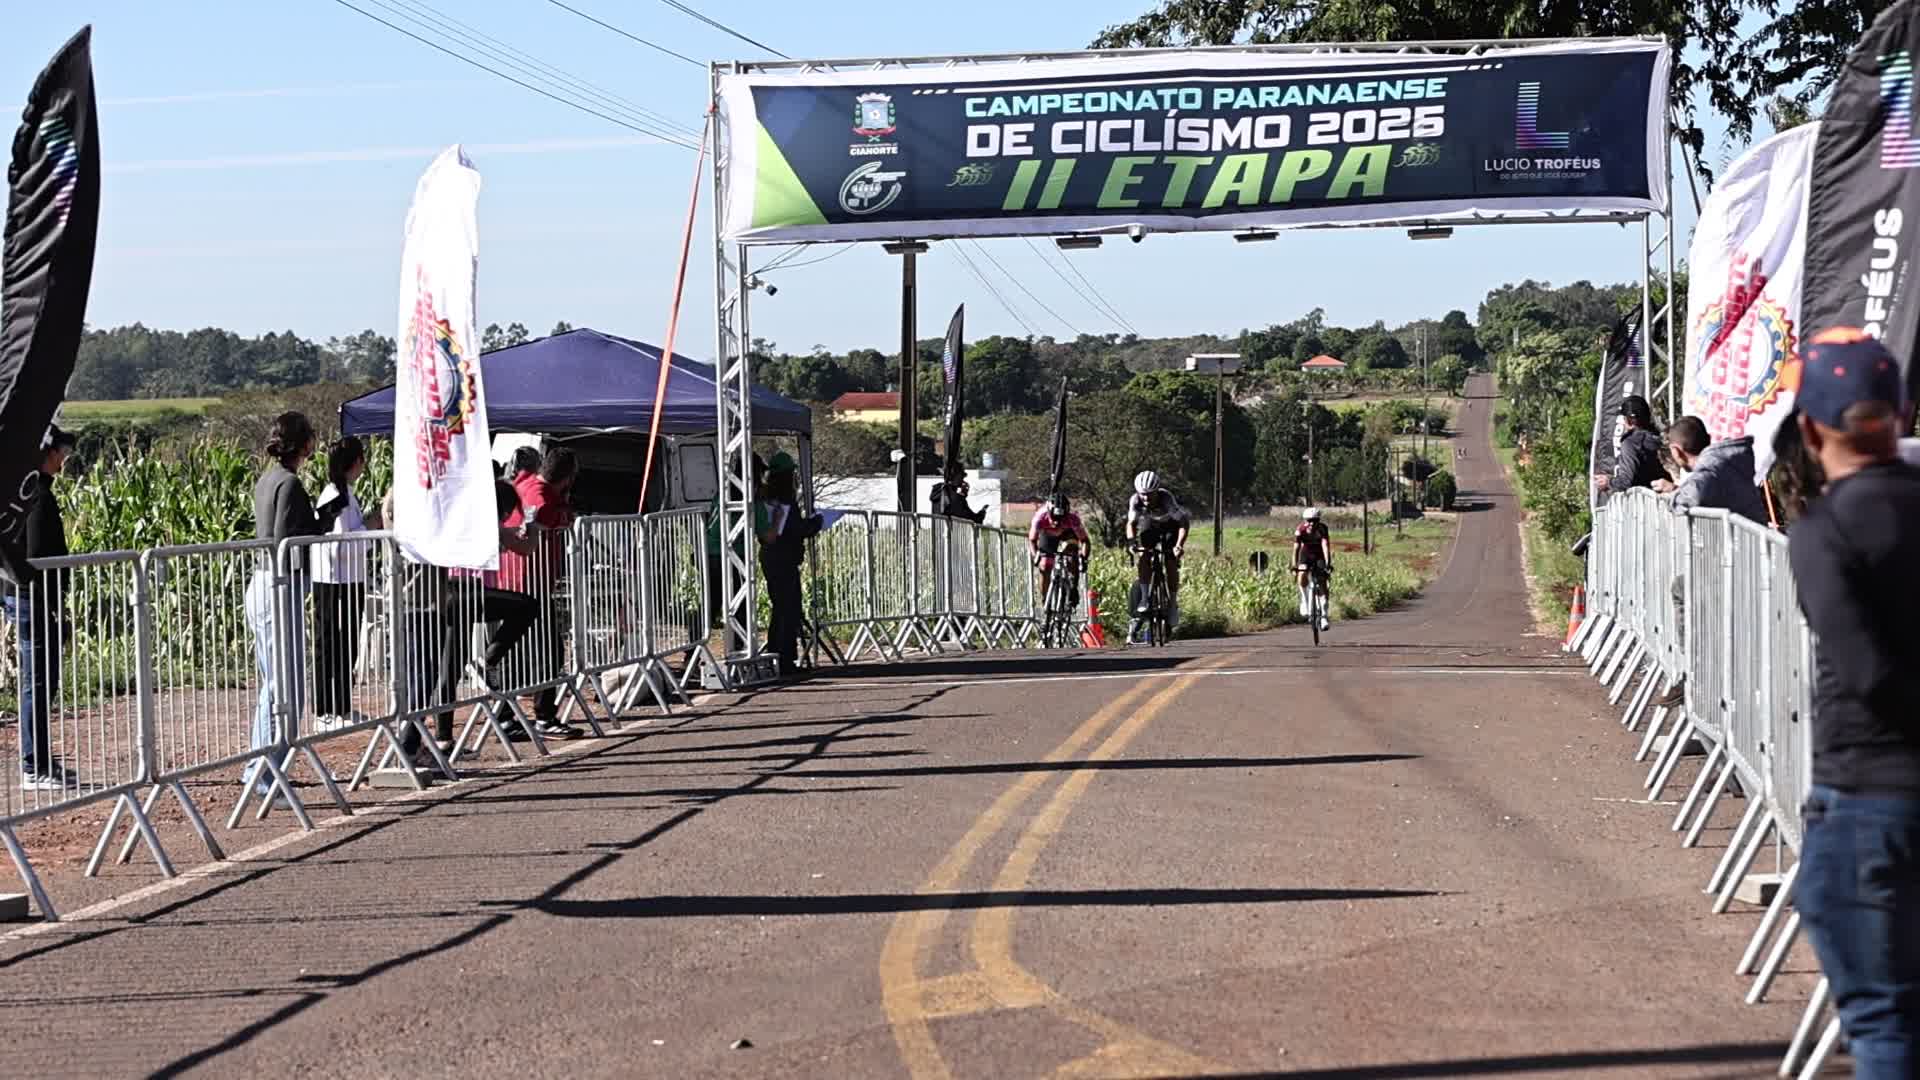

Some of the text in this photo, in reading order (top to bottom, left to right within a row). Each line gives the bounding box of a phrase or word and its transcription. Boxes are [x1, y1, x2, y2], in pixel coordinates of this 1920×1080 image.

[966, 77, 1449, 117] CAMPEONATO PARANAENSE
[850, 146, 899, 156] CIANORTE
[966, 105, 1445, 157] DE CICLÍSMO 2025
[1002, 144, 1392, 210] II ETAPA
[1484, 155, 1601, 171] LUCIO TROFÉUS
